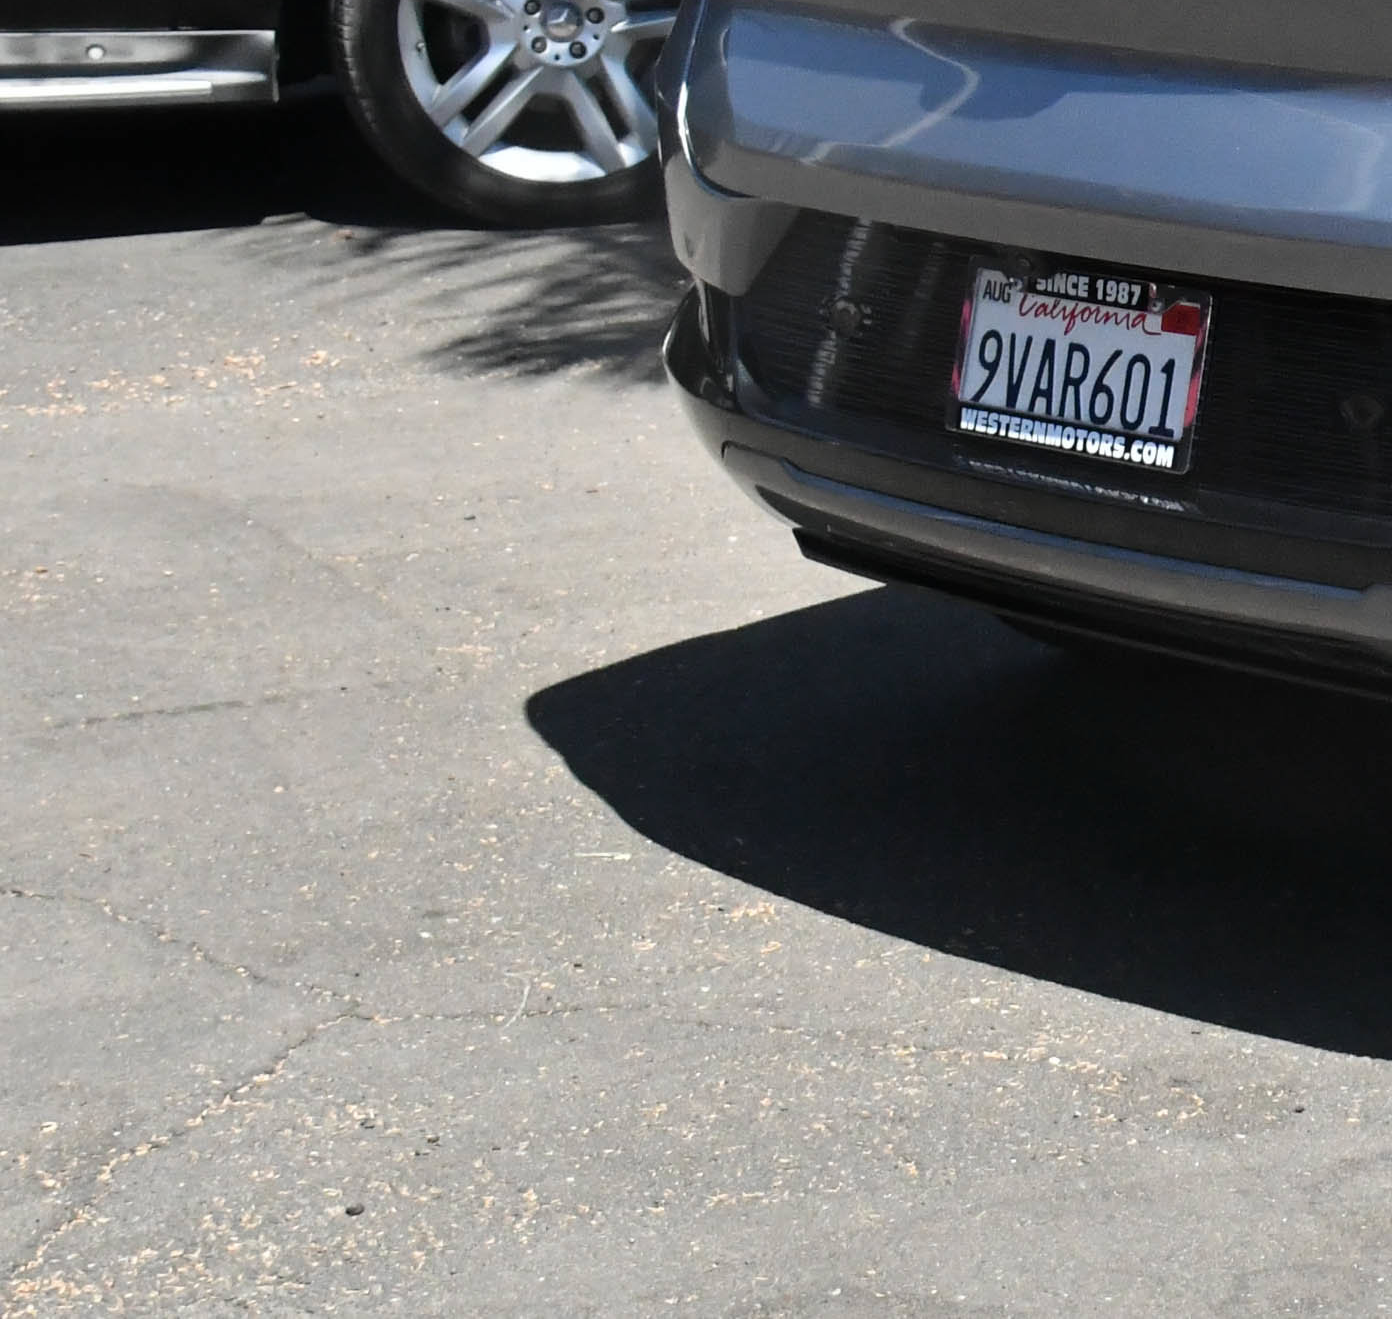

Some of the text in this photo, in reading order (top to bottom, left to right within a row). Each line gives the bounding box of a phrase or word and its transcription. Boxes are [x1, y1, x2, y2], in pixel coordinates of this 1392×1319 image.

[981, 279, 1013, 304] AUG
[1096, 278, 1142, 306] 1987
[1017, 293, 1163, 336] California
[970, 328, 1177, 438] 9VAR601
[960, 407, 1176, 469] WESTERNMOTORS.COM
